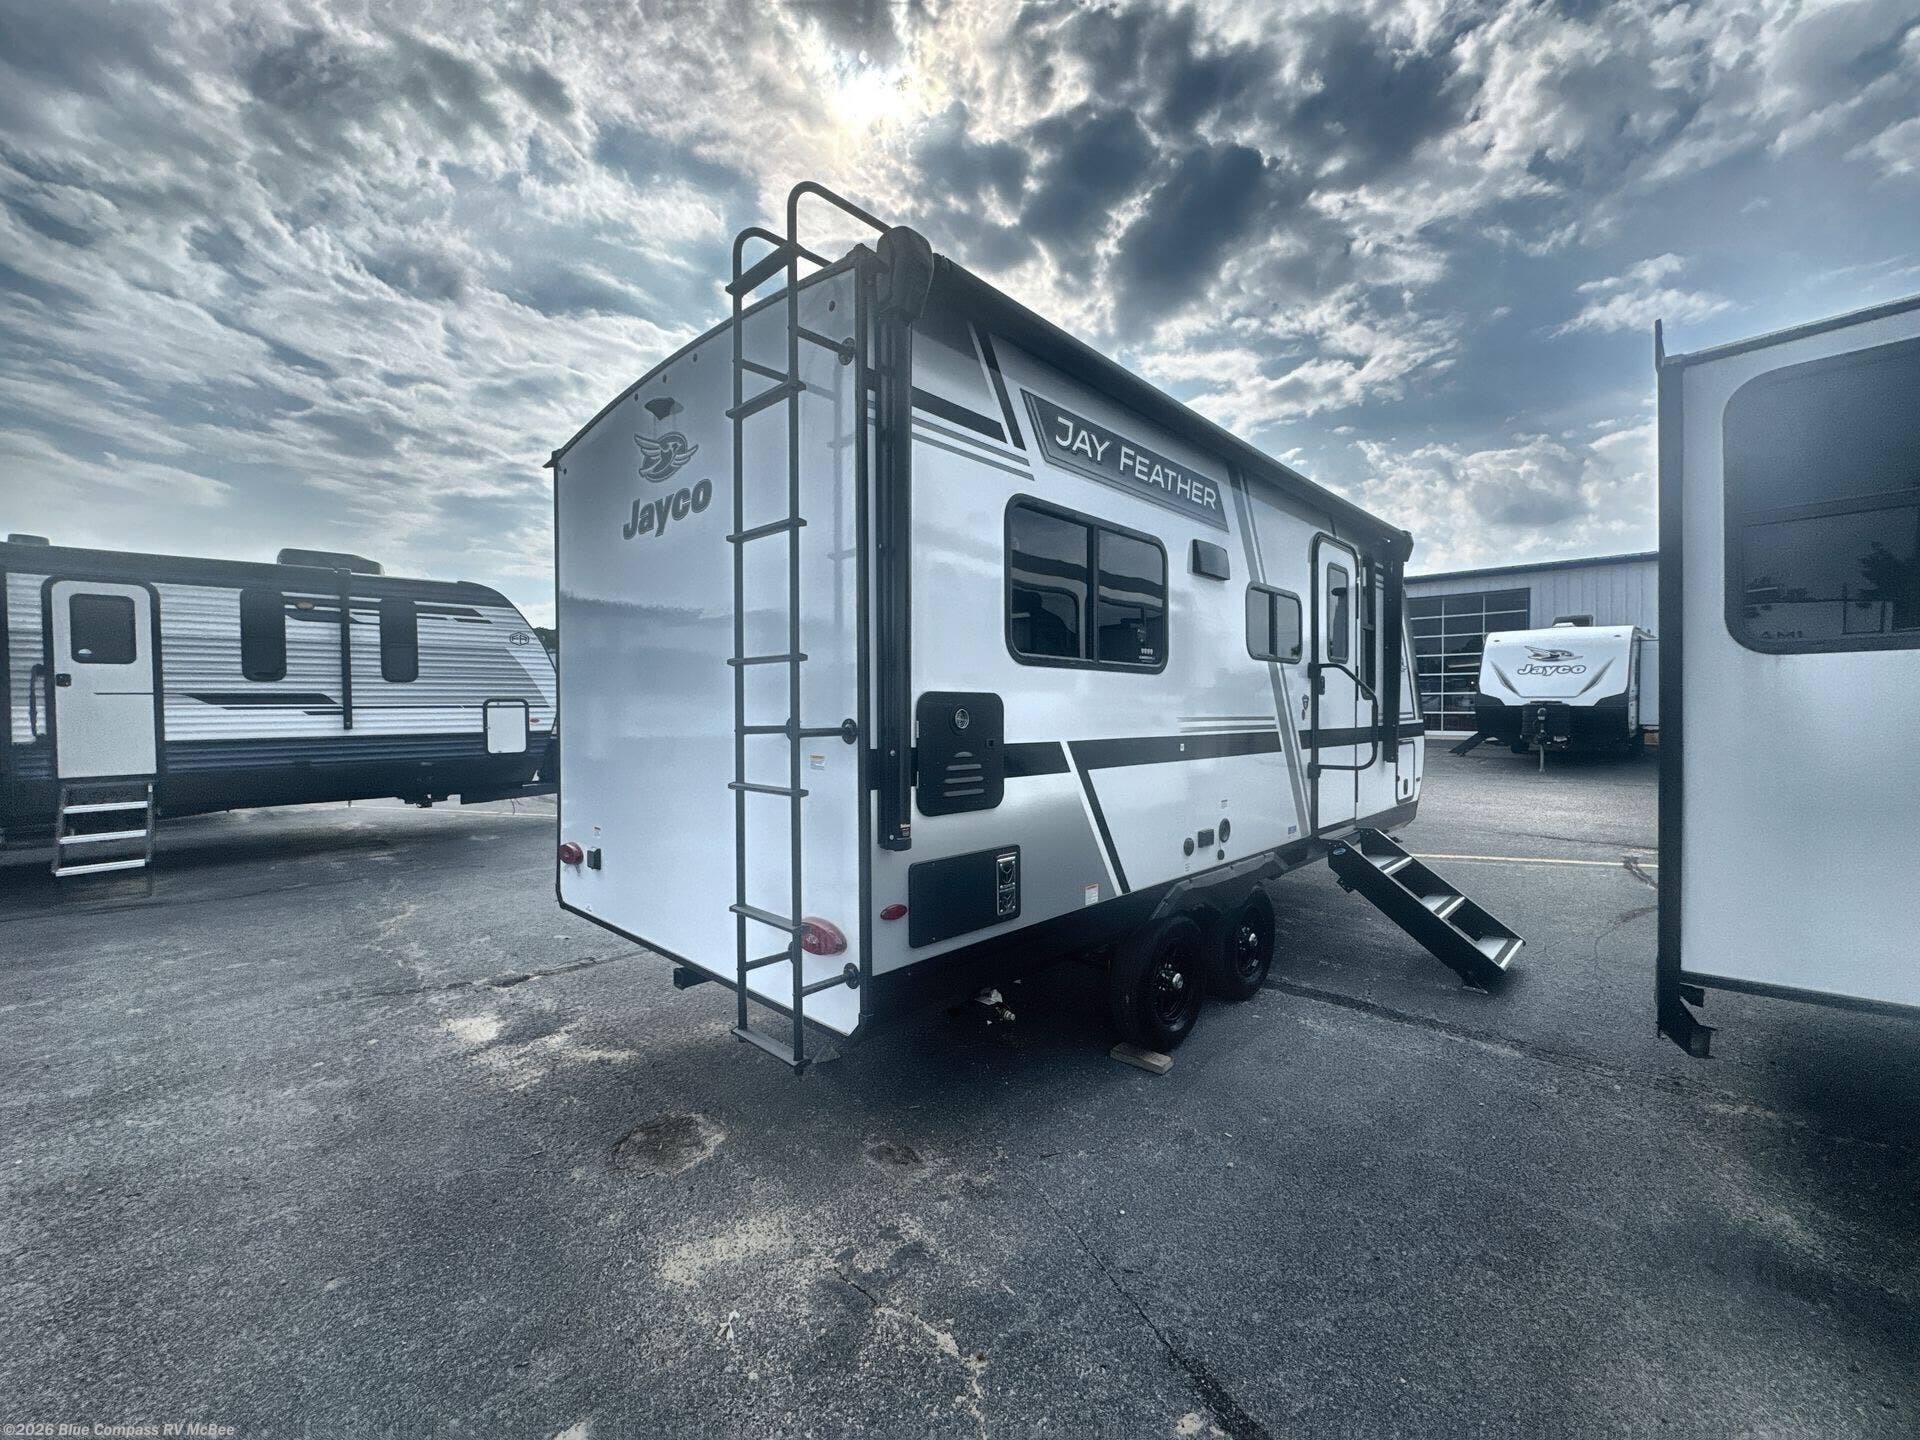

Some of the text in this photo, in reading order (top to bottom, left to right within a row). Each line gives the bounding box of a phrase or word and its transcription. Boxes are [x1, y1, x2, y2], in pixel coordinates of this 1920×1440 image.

[1055, 416, 1217, 510] JAY FEATHER
[622, 478, 713, 540] Jayco
[1518, 664, 1586, 676] Jayco
